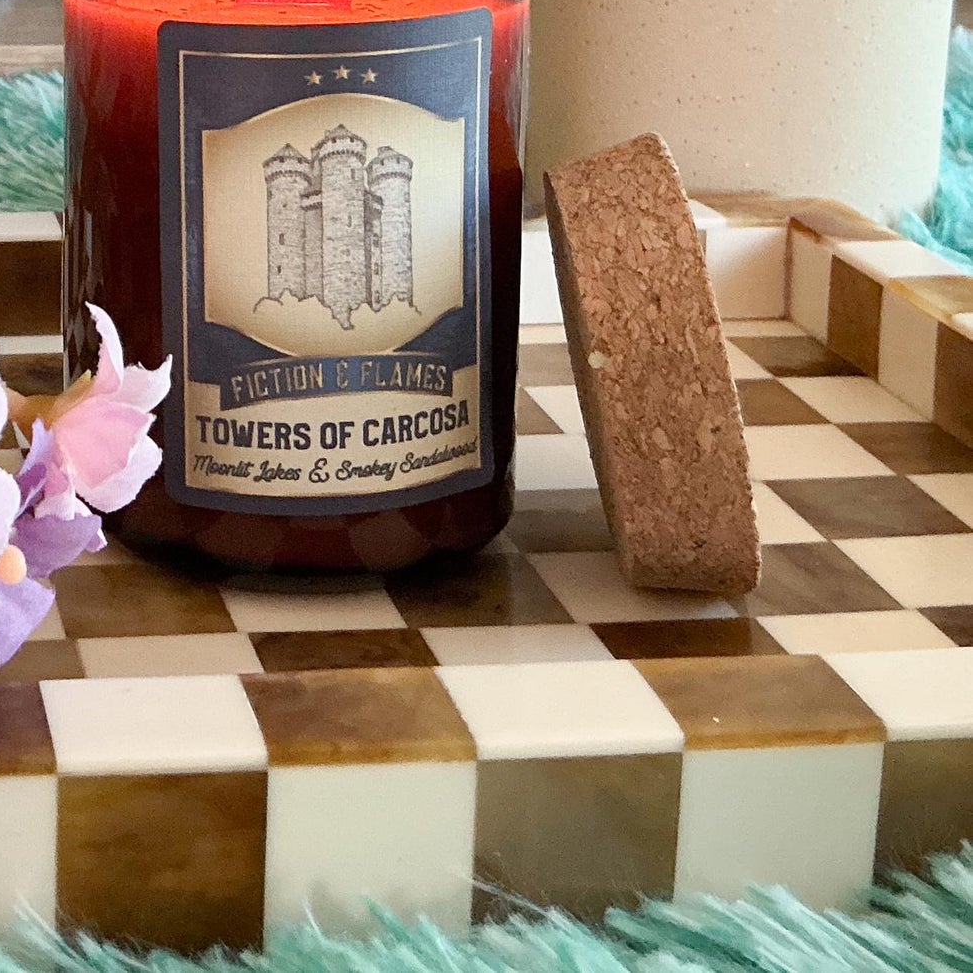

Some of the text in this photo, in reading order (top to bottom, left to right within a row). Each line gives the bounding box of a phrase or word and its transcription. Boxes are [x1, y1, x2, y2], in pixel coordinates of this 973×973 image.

[231, 361, 324, 403] FICTION
[360, 360, 447, 391] FLAMES
[195, 399, 470, 451] TOWERS OF CARCOSA
[192, 439, 478, 484] Moonlit Lakes & Smokey Sandalwood
